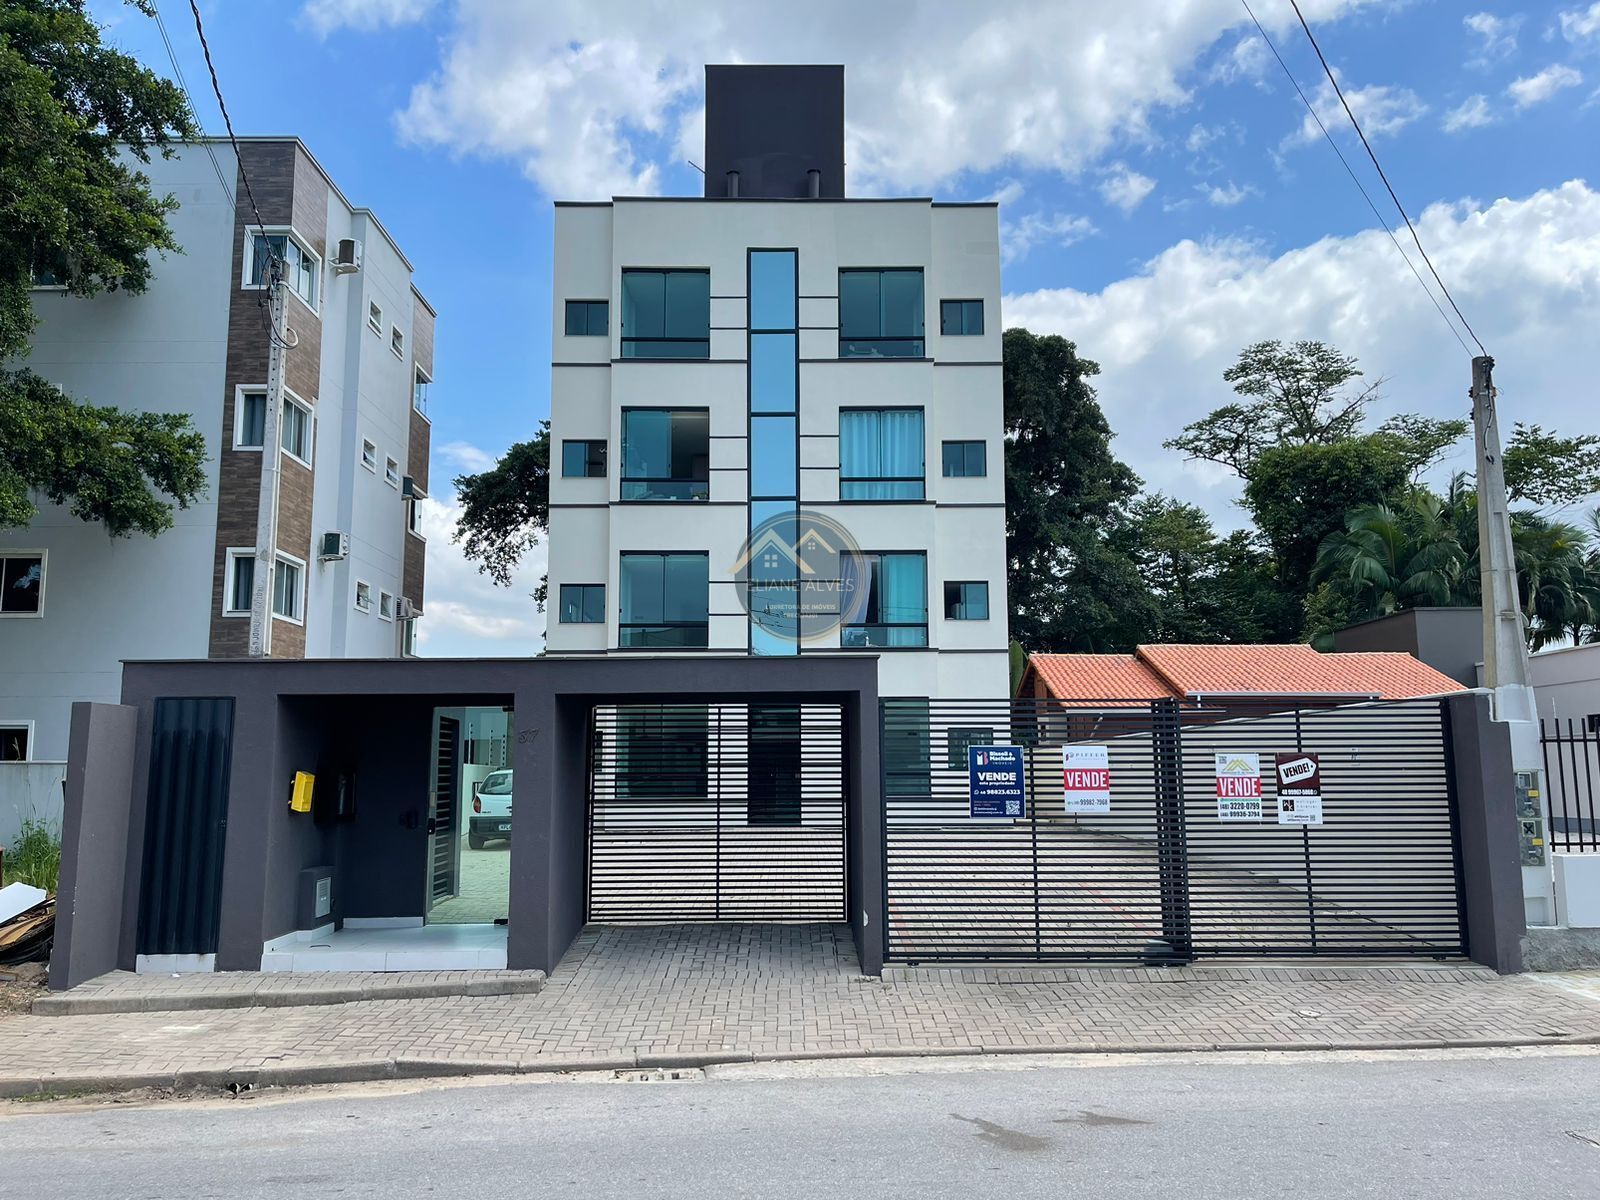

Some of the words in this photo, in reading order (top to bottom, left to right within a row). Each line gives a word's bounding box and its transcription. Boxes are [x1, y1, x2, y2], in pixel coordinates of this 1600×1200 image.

[978, 772, 1016, 780] VENDE
[1283, 762, 1310, 778] VENDE!
[1066, 772, 1107, 787] VENDE
[1219, 778, 1258, 796] VENDE
